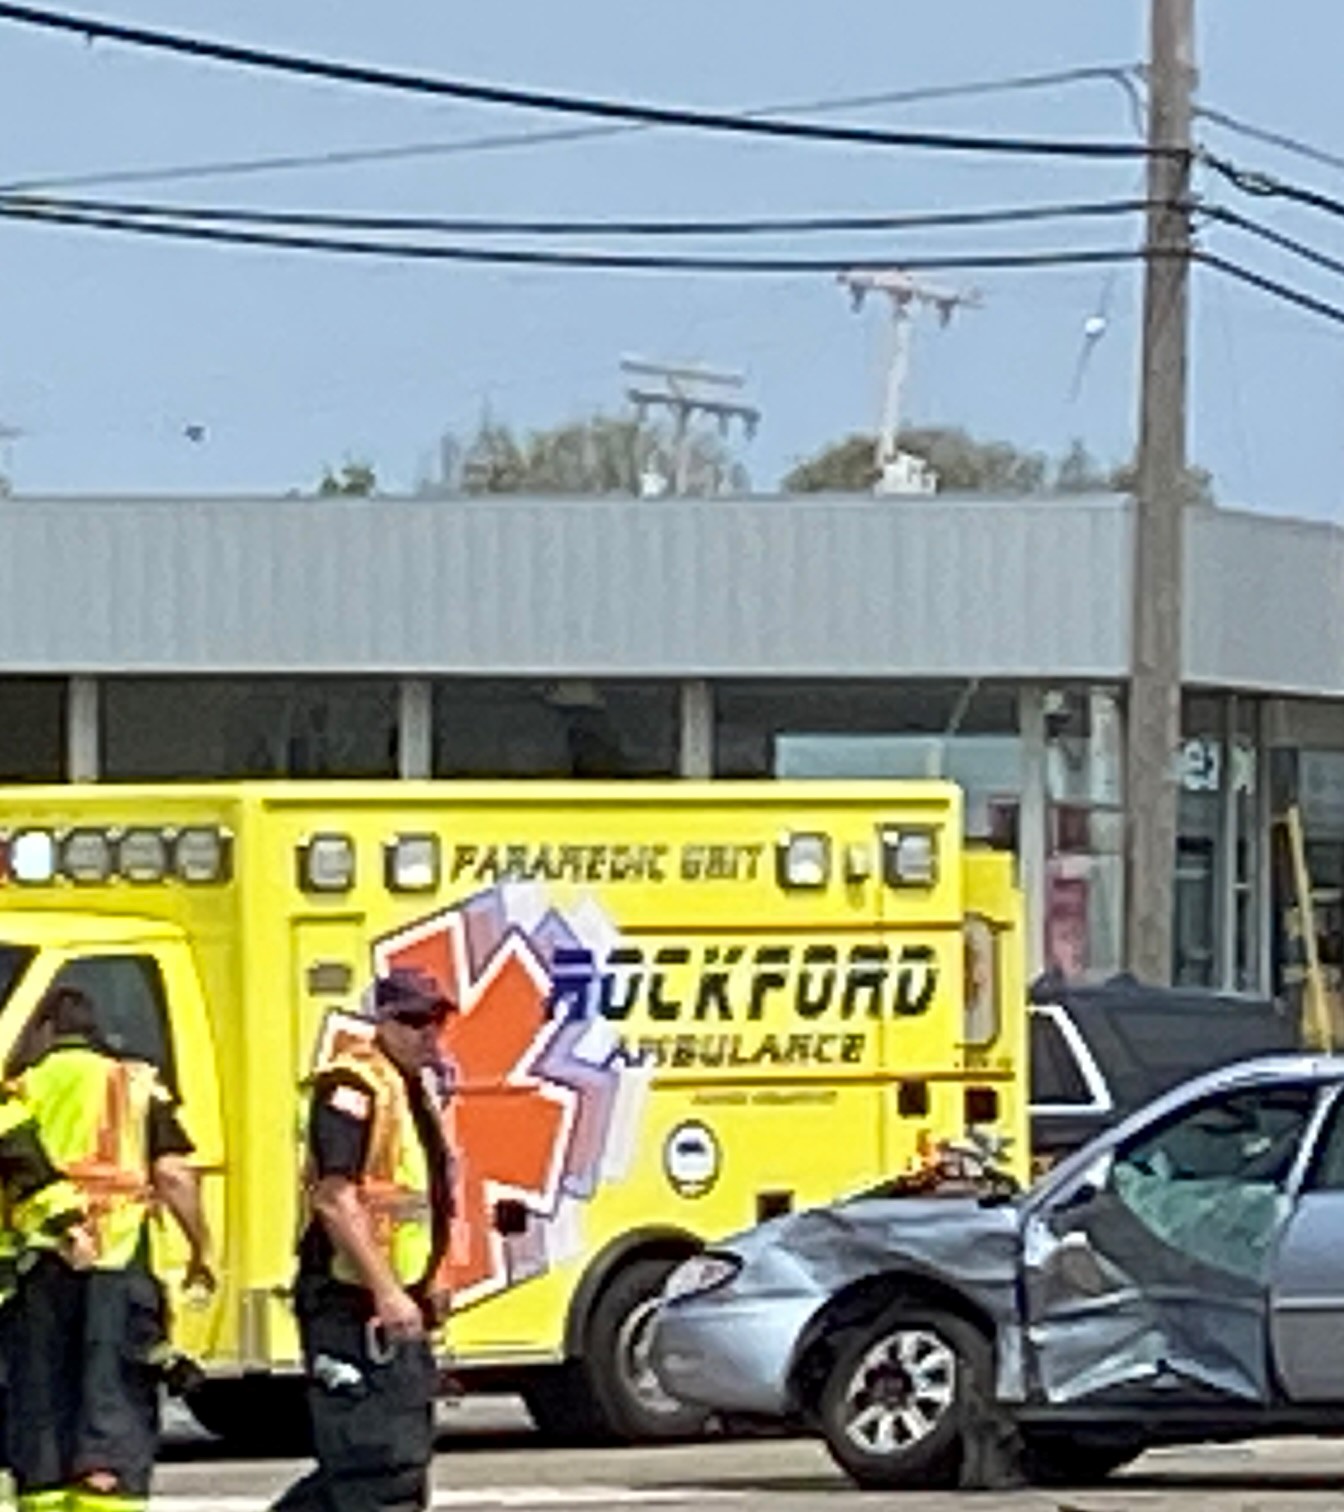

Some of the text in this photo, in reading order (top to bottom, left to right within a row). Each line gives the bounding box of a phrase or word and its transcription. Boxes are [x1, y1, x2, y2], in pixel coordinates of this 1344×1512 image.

[450, 844, 669, 884] PARAMEDIC
[546, 943, 938, 1021] ROCKFORD
[602, 1031, 867, 1071] AMBULANCE
